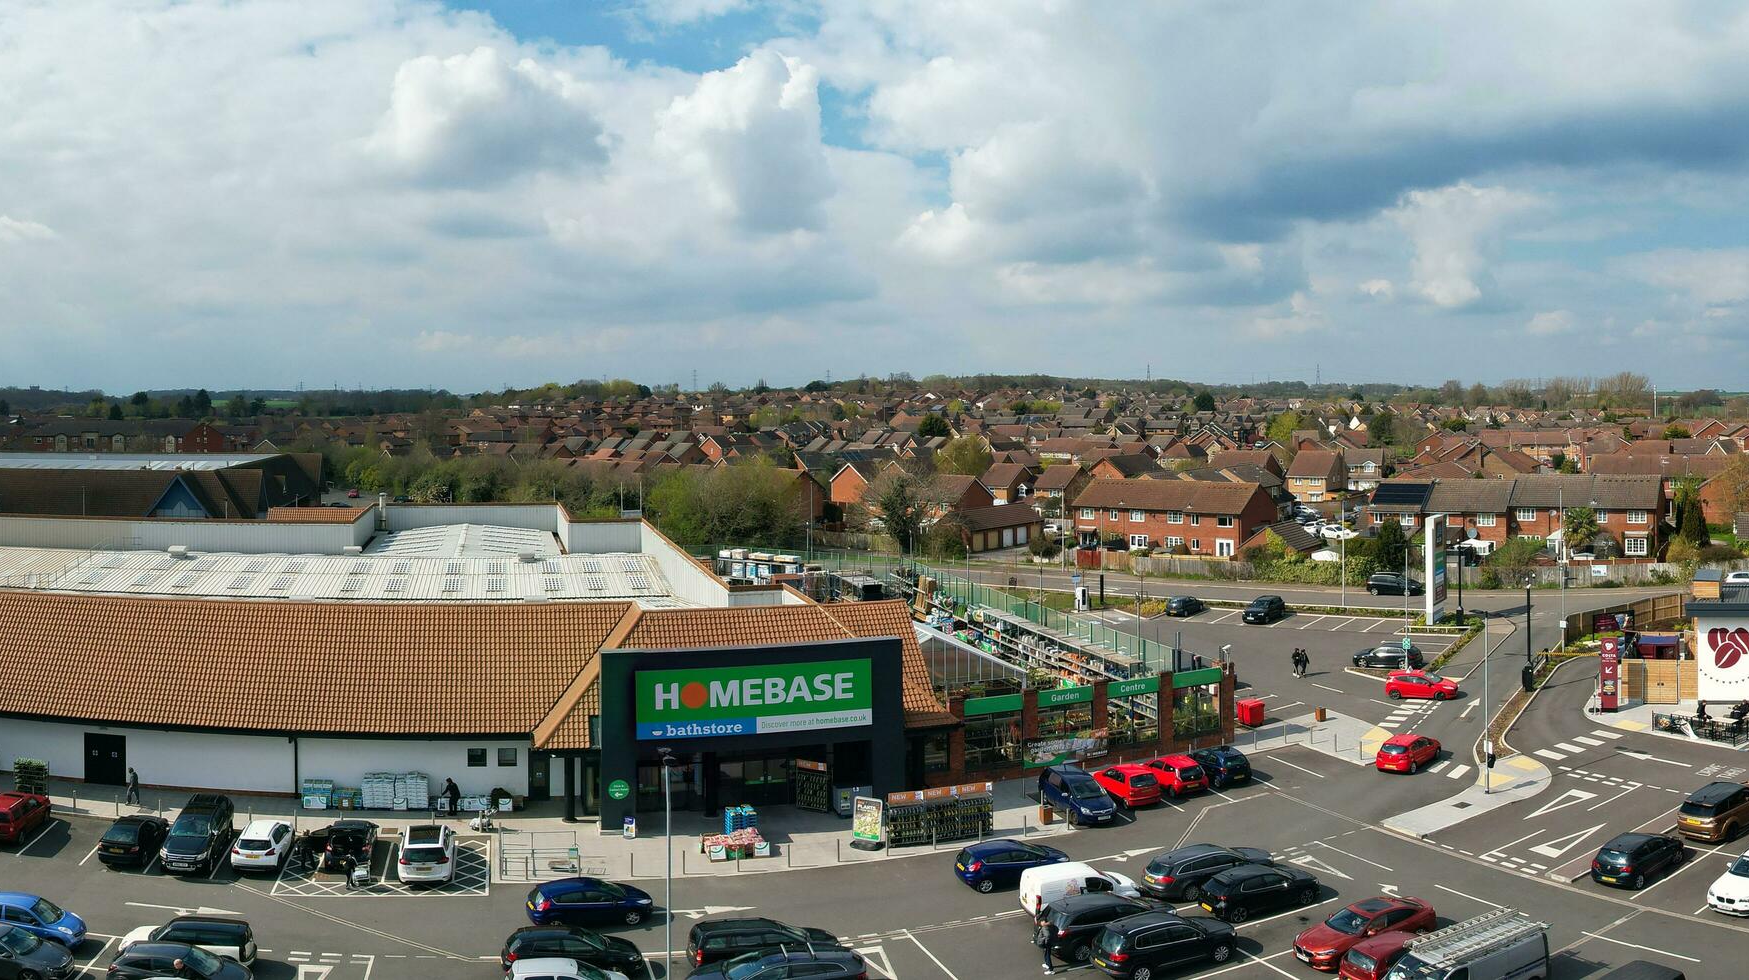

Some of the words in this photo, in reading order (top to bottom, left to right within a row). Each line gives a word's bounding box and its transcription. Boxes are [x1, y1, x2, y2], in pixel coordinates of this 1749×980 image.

[654, 672, 854, 710] HOMEBASE
[1120, 682, 1146, 693] Centre
[1051, 691, 1080, 702] Garden
[761, 720, 789, 729] Discover
[790, 719, 807, 727] more
[815, 714, 867, 725] homebase.co.uk
[666, 722, 743, 737] bathstore
[1027, 740, 1047, 748] Create
